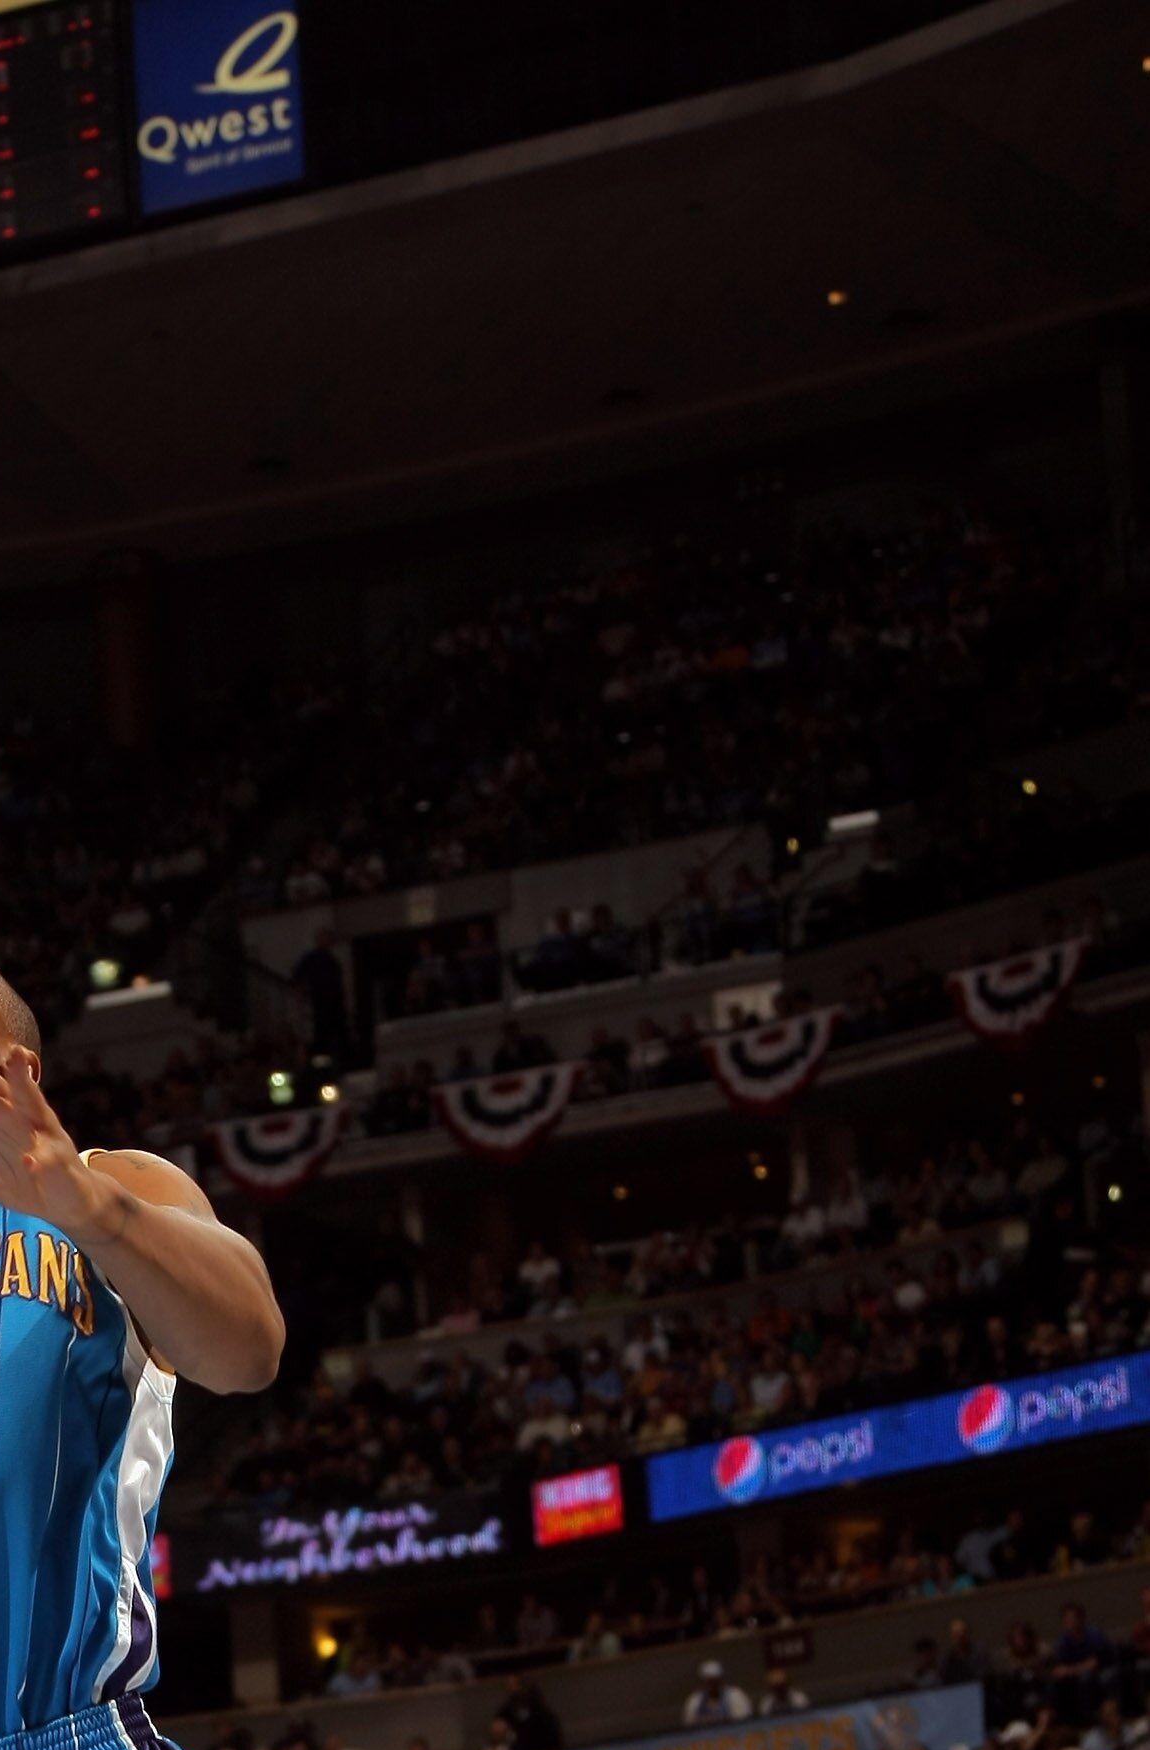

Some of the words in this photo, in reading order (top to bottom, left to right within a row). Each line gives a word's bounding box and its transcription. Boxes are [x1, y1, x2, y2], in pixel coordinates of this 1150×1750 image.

[137, 98, 292, 164] Qwest
[1016, 1365, 1130, 1433] pepsi
[767, 1419, 874, 1483] pepsi
[197, 1517, 502, 1592] Neighborhood
